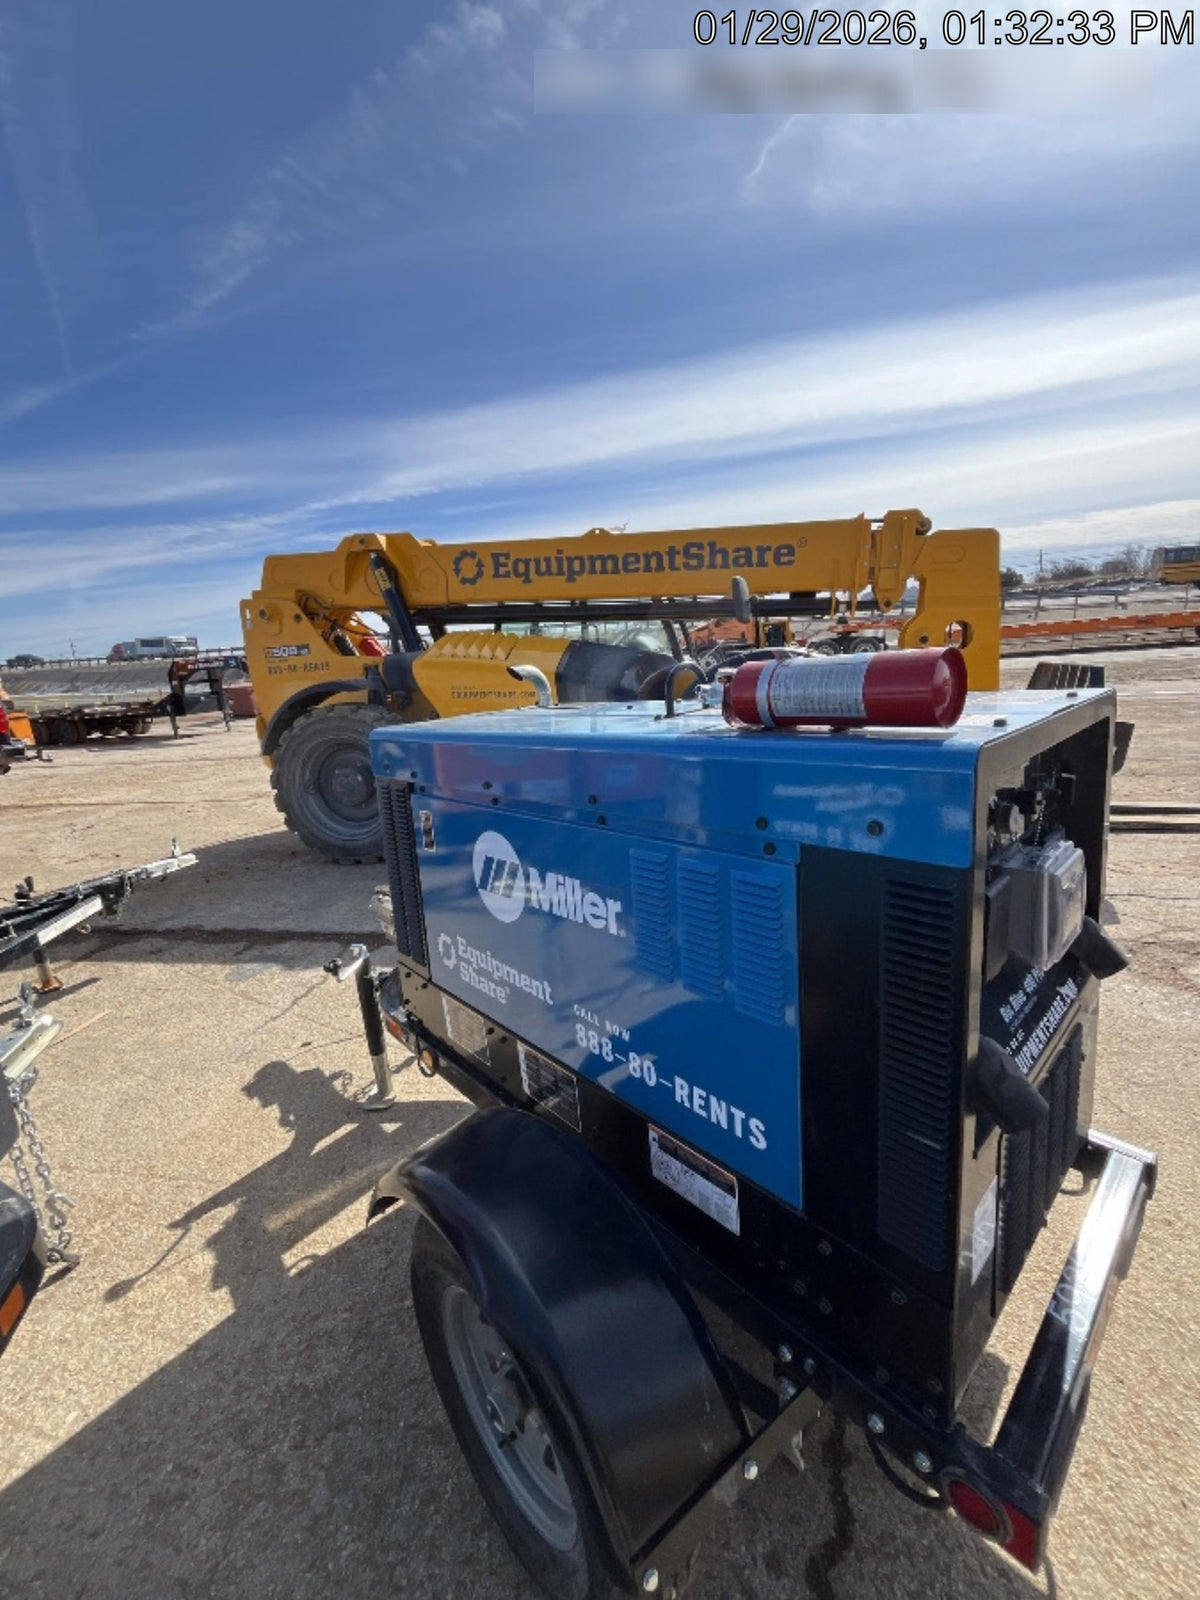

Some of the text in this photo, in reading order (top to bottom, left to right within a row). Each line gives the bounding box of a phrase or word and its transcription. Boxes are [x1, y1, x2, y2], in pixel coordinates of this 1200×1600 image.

[491, 541, 796, 584] EquipmentShare
[528, 866, 622, 936] Miller
[457, 936, 553, 1005] Equipment
[460, 961, 507, 1004] Share
[573, 1004, 630, 1042] CALL NOW
[576, 1023, 767, 1151] 888-80-RENTS
